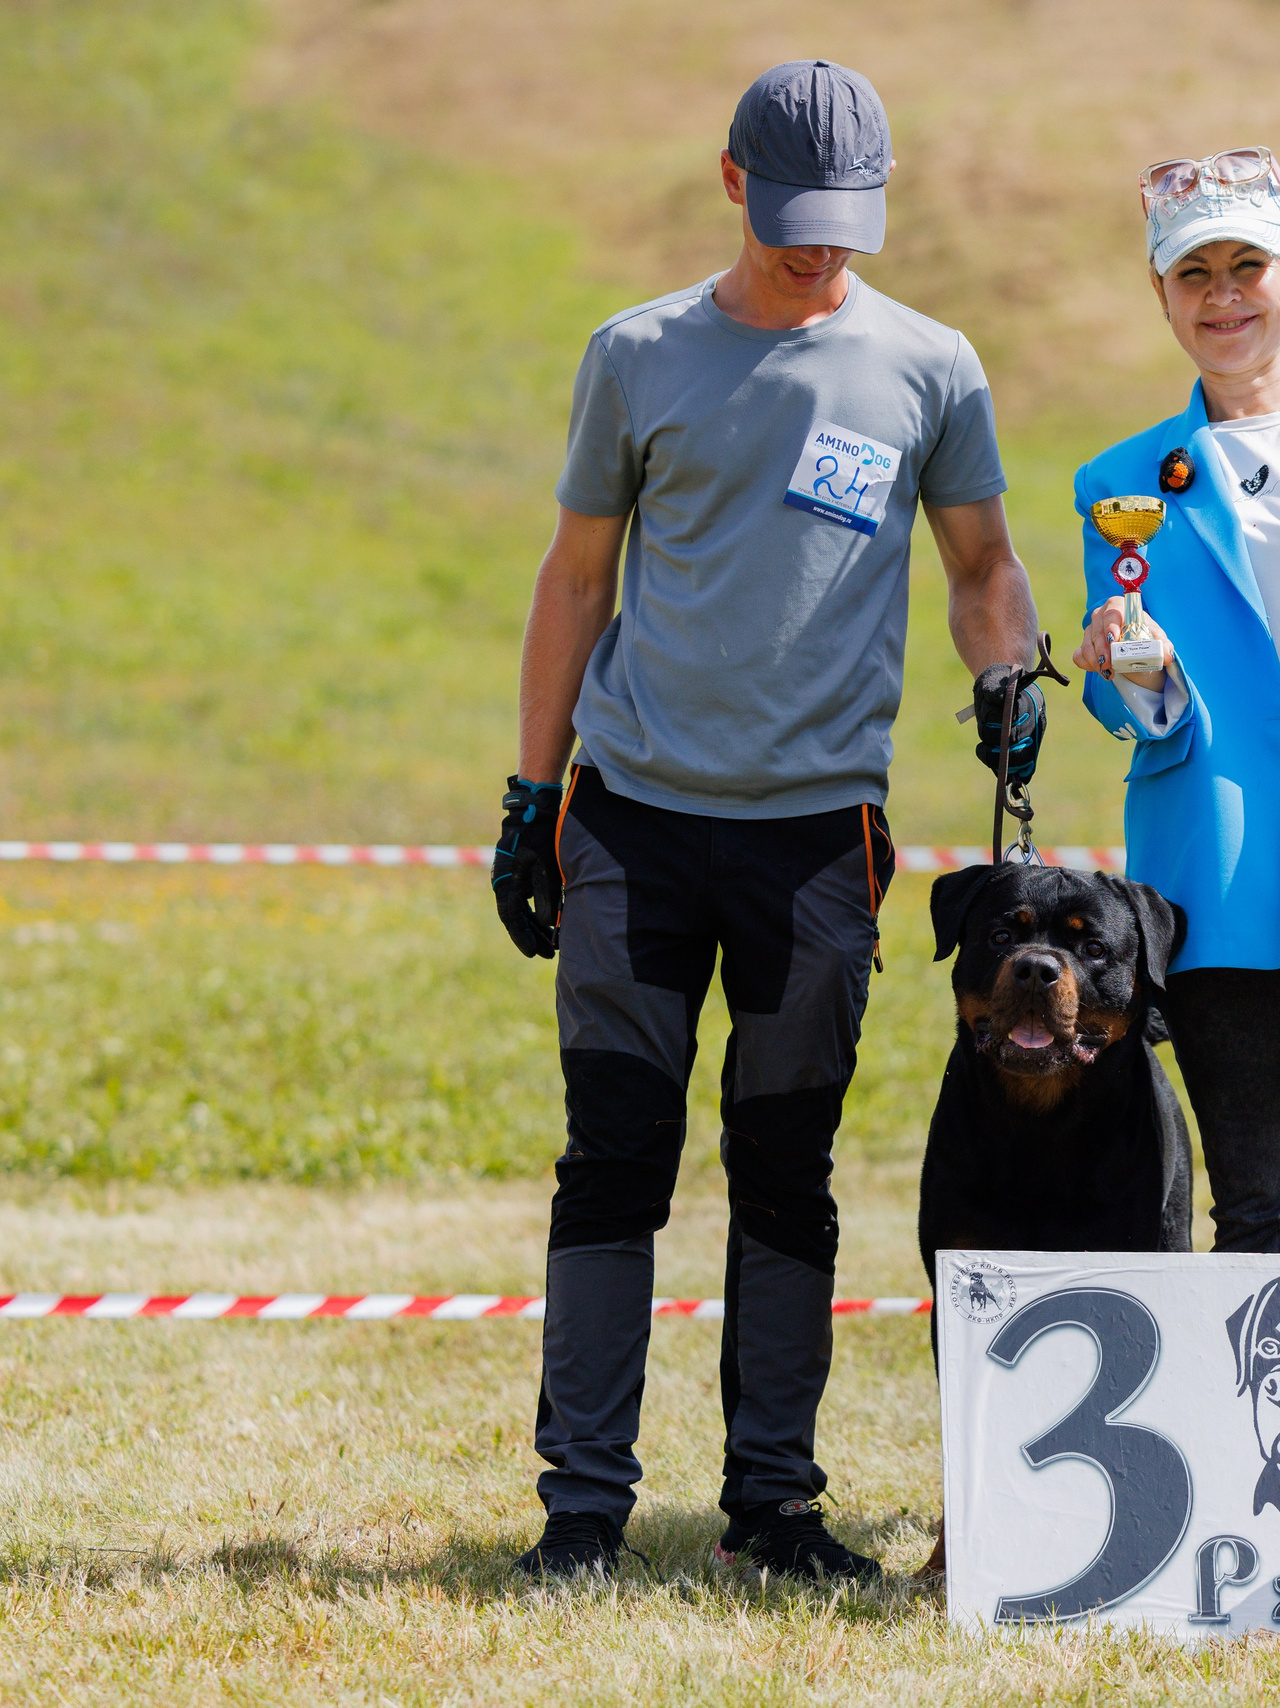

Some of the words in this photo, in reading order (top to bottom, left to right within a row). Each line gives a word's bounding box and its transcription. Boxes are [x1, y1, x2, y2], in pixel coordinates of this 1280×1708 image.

[813, 455, 869, 514] 24
[980, 1263, 1003, 1274] КЛУБ
[1004, 1274, 1016, 1308] РОССИИ
[987, 1286, 1193, 1627] 3
